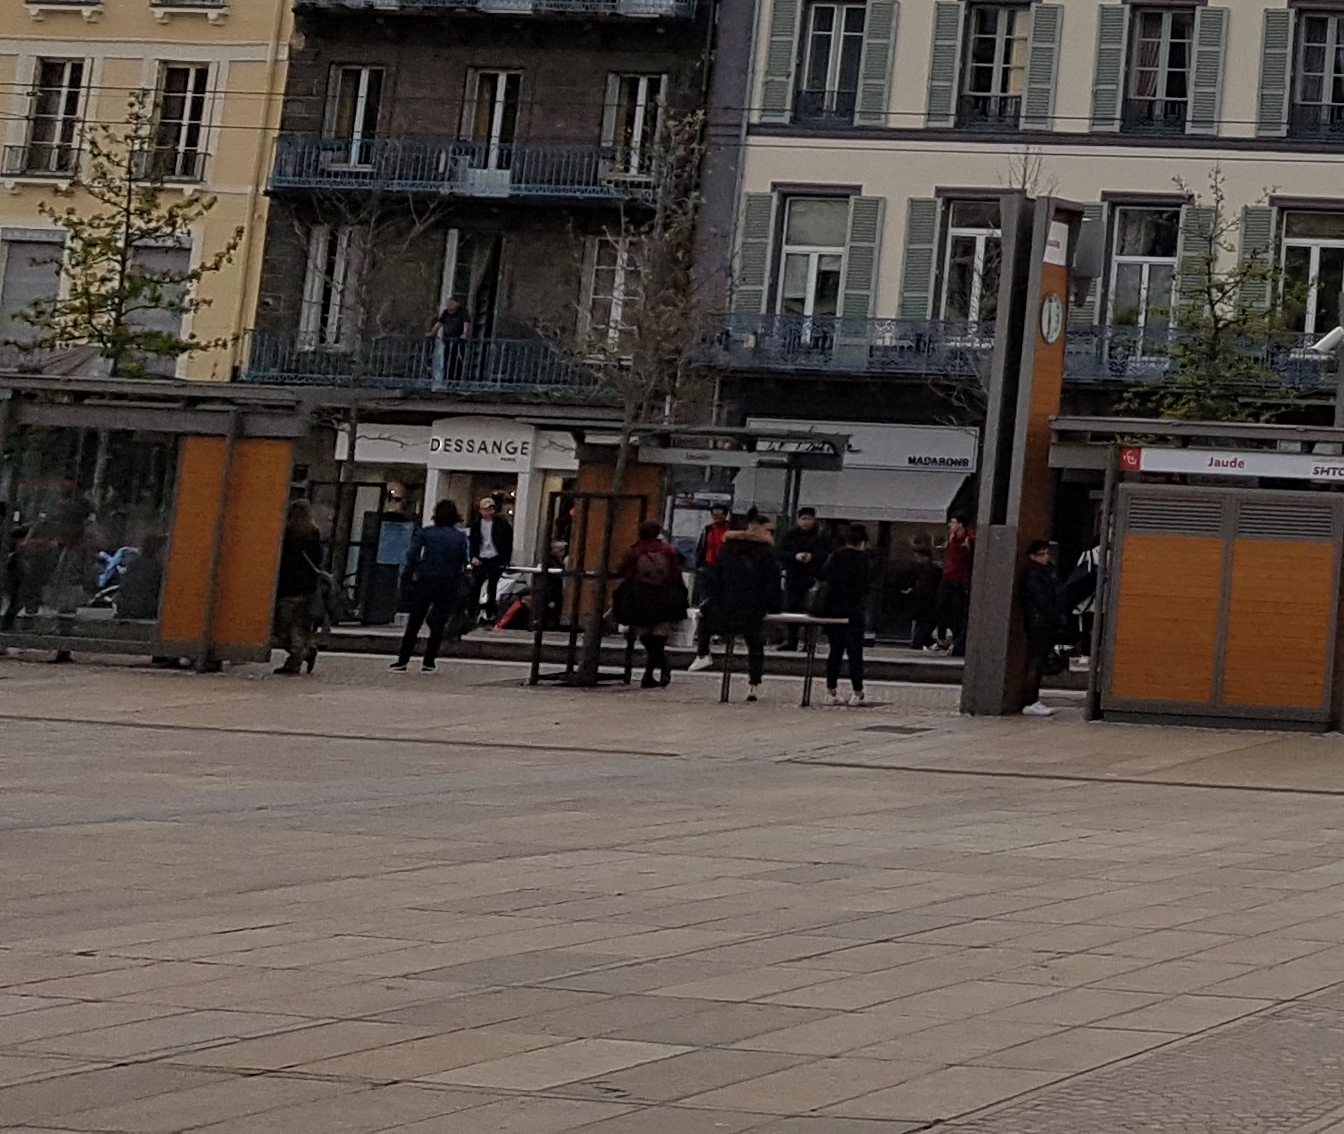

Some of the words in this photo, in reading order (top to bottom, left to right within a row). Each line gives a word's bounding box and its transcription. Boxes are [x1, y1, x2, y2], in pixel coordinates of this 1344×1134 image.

[430, 438, 530, 456] DESSANGE
[907, 455, 969, 467] MACARONS
[1208, 457, 1245, 469] Jaude
